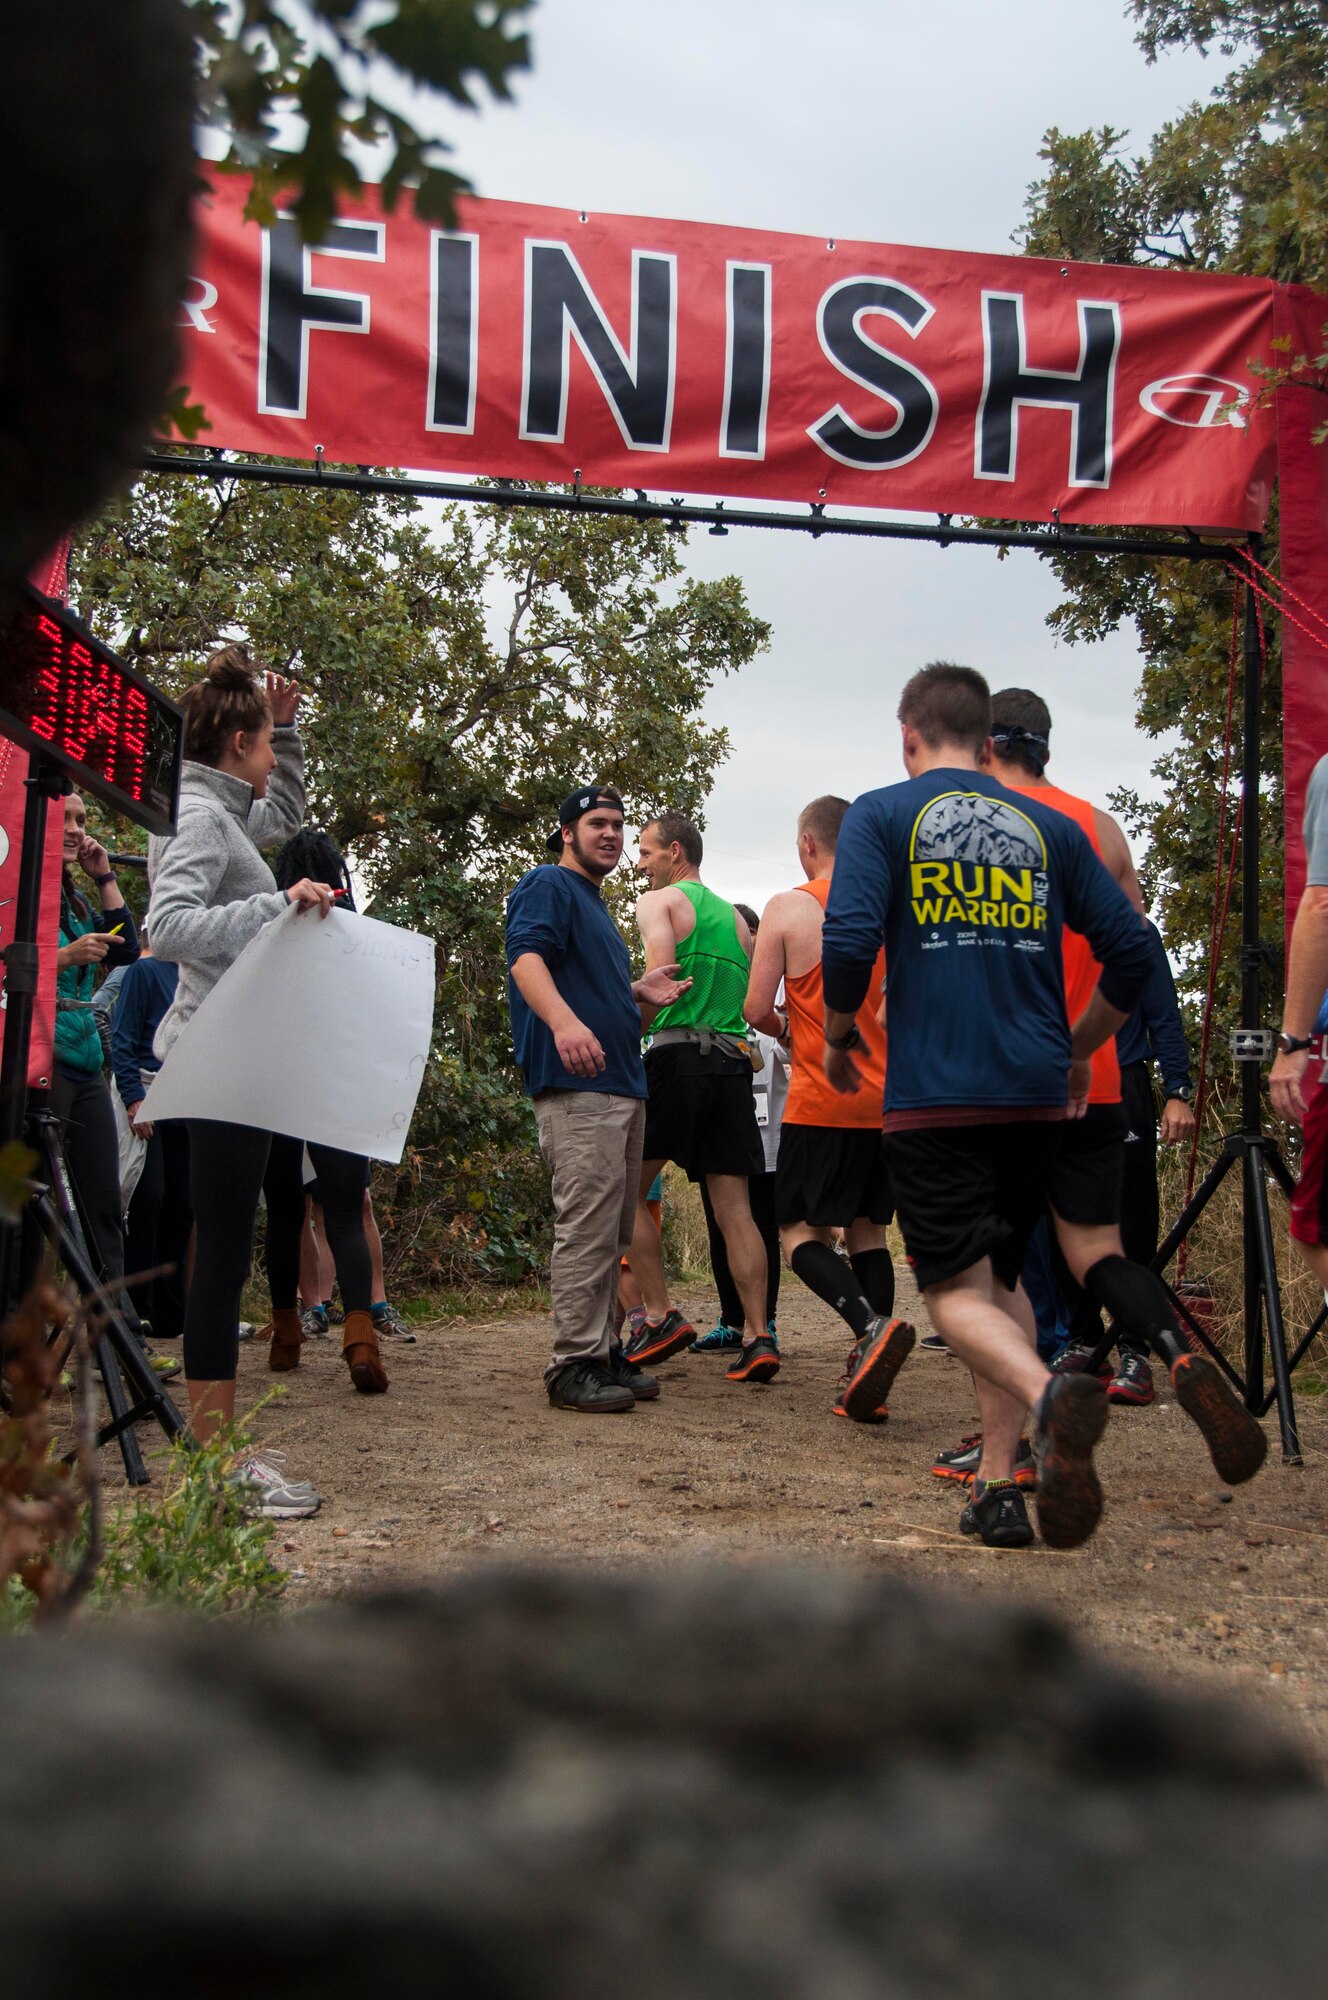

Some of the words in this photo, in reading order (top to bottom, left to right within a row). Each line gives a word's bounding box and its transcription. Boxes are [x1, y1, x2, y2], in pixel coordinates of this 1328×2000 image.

[258, 211, 1122, 490] FINISH
[911, 861, 1033, 903] RUN
[1033, 880, 1049, 906] LIKE
[911, 897, 1047, 932] WARRIOR
